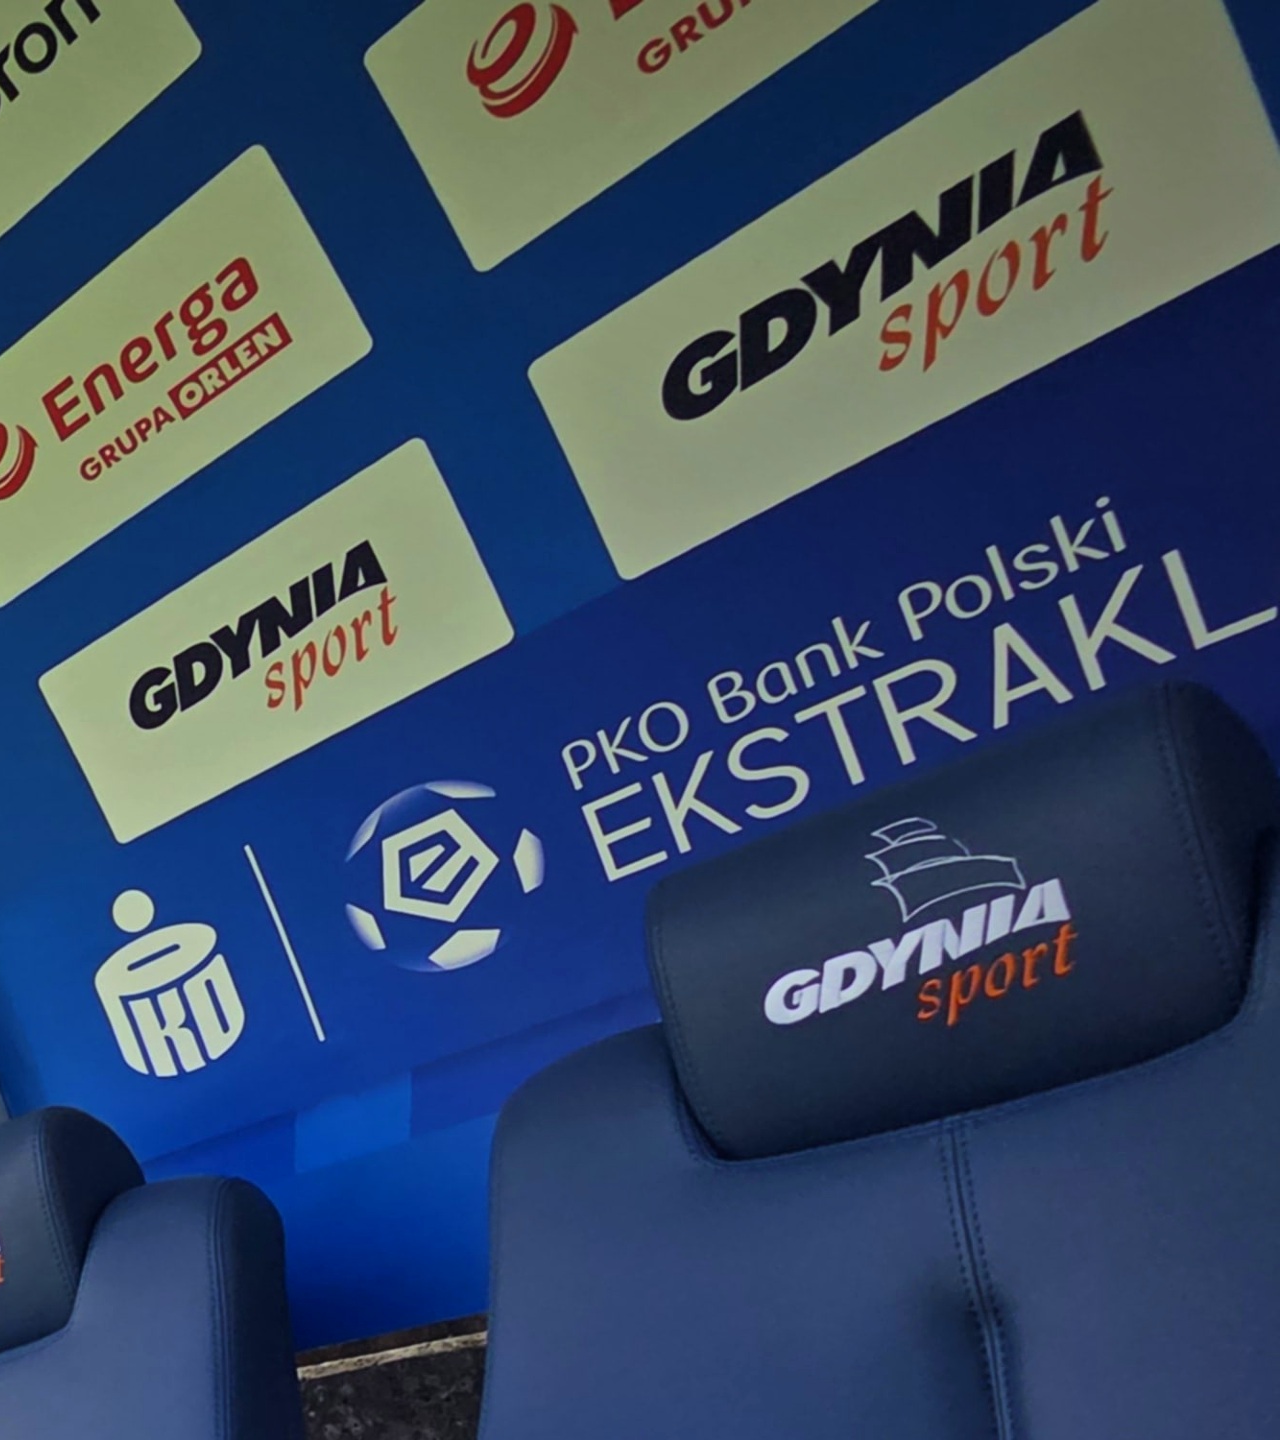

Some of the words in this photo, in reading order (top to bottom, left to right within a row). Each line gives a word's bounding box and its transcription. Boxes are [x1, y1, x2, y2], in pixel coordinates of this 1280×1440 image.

[636, 0, 752, 74] GRU
[41, 257, 259, 442] Energa
[661, 109, 1104, 421] GDYNIA
[878, 174, 1115, 373] sport
[79, 406, 175, 482] GRUPA
[175, 318, 287, 418] ORLEN
[129, 539, 387, 730] GDYNIA
[265, 586, 399, 717] sport
[561, 703, 690, 791] PKO
[705, 618, 886, 726] Bank
[898, 496, 1128, 644] Polski
[580, 549, 1278, 882] EKSTRAKL
[762, 877, 1072, 1027] GDYNIA
[914, 922, 1079, 1027] sport
